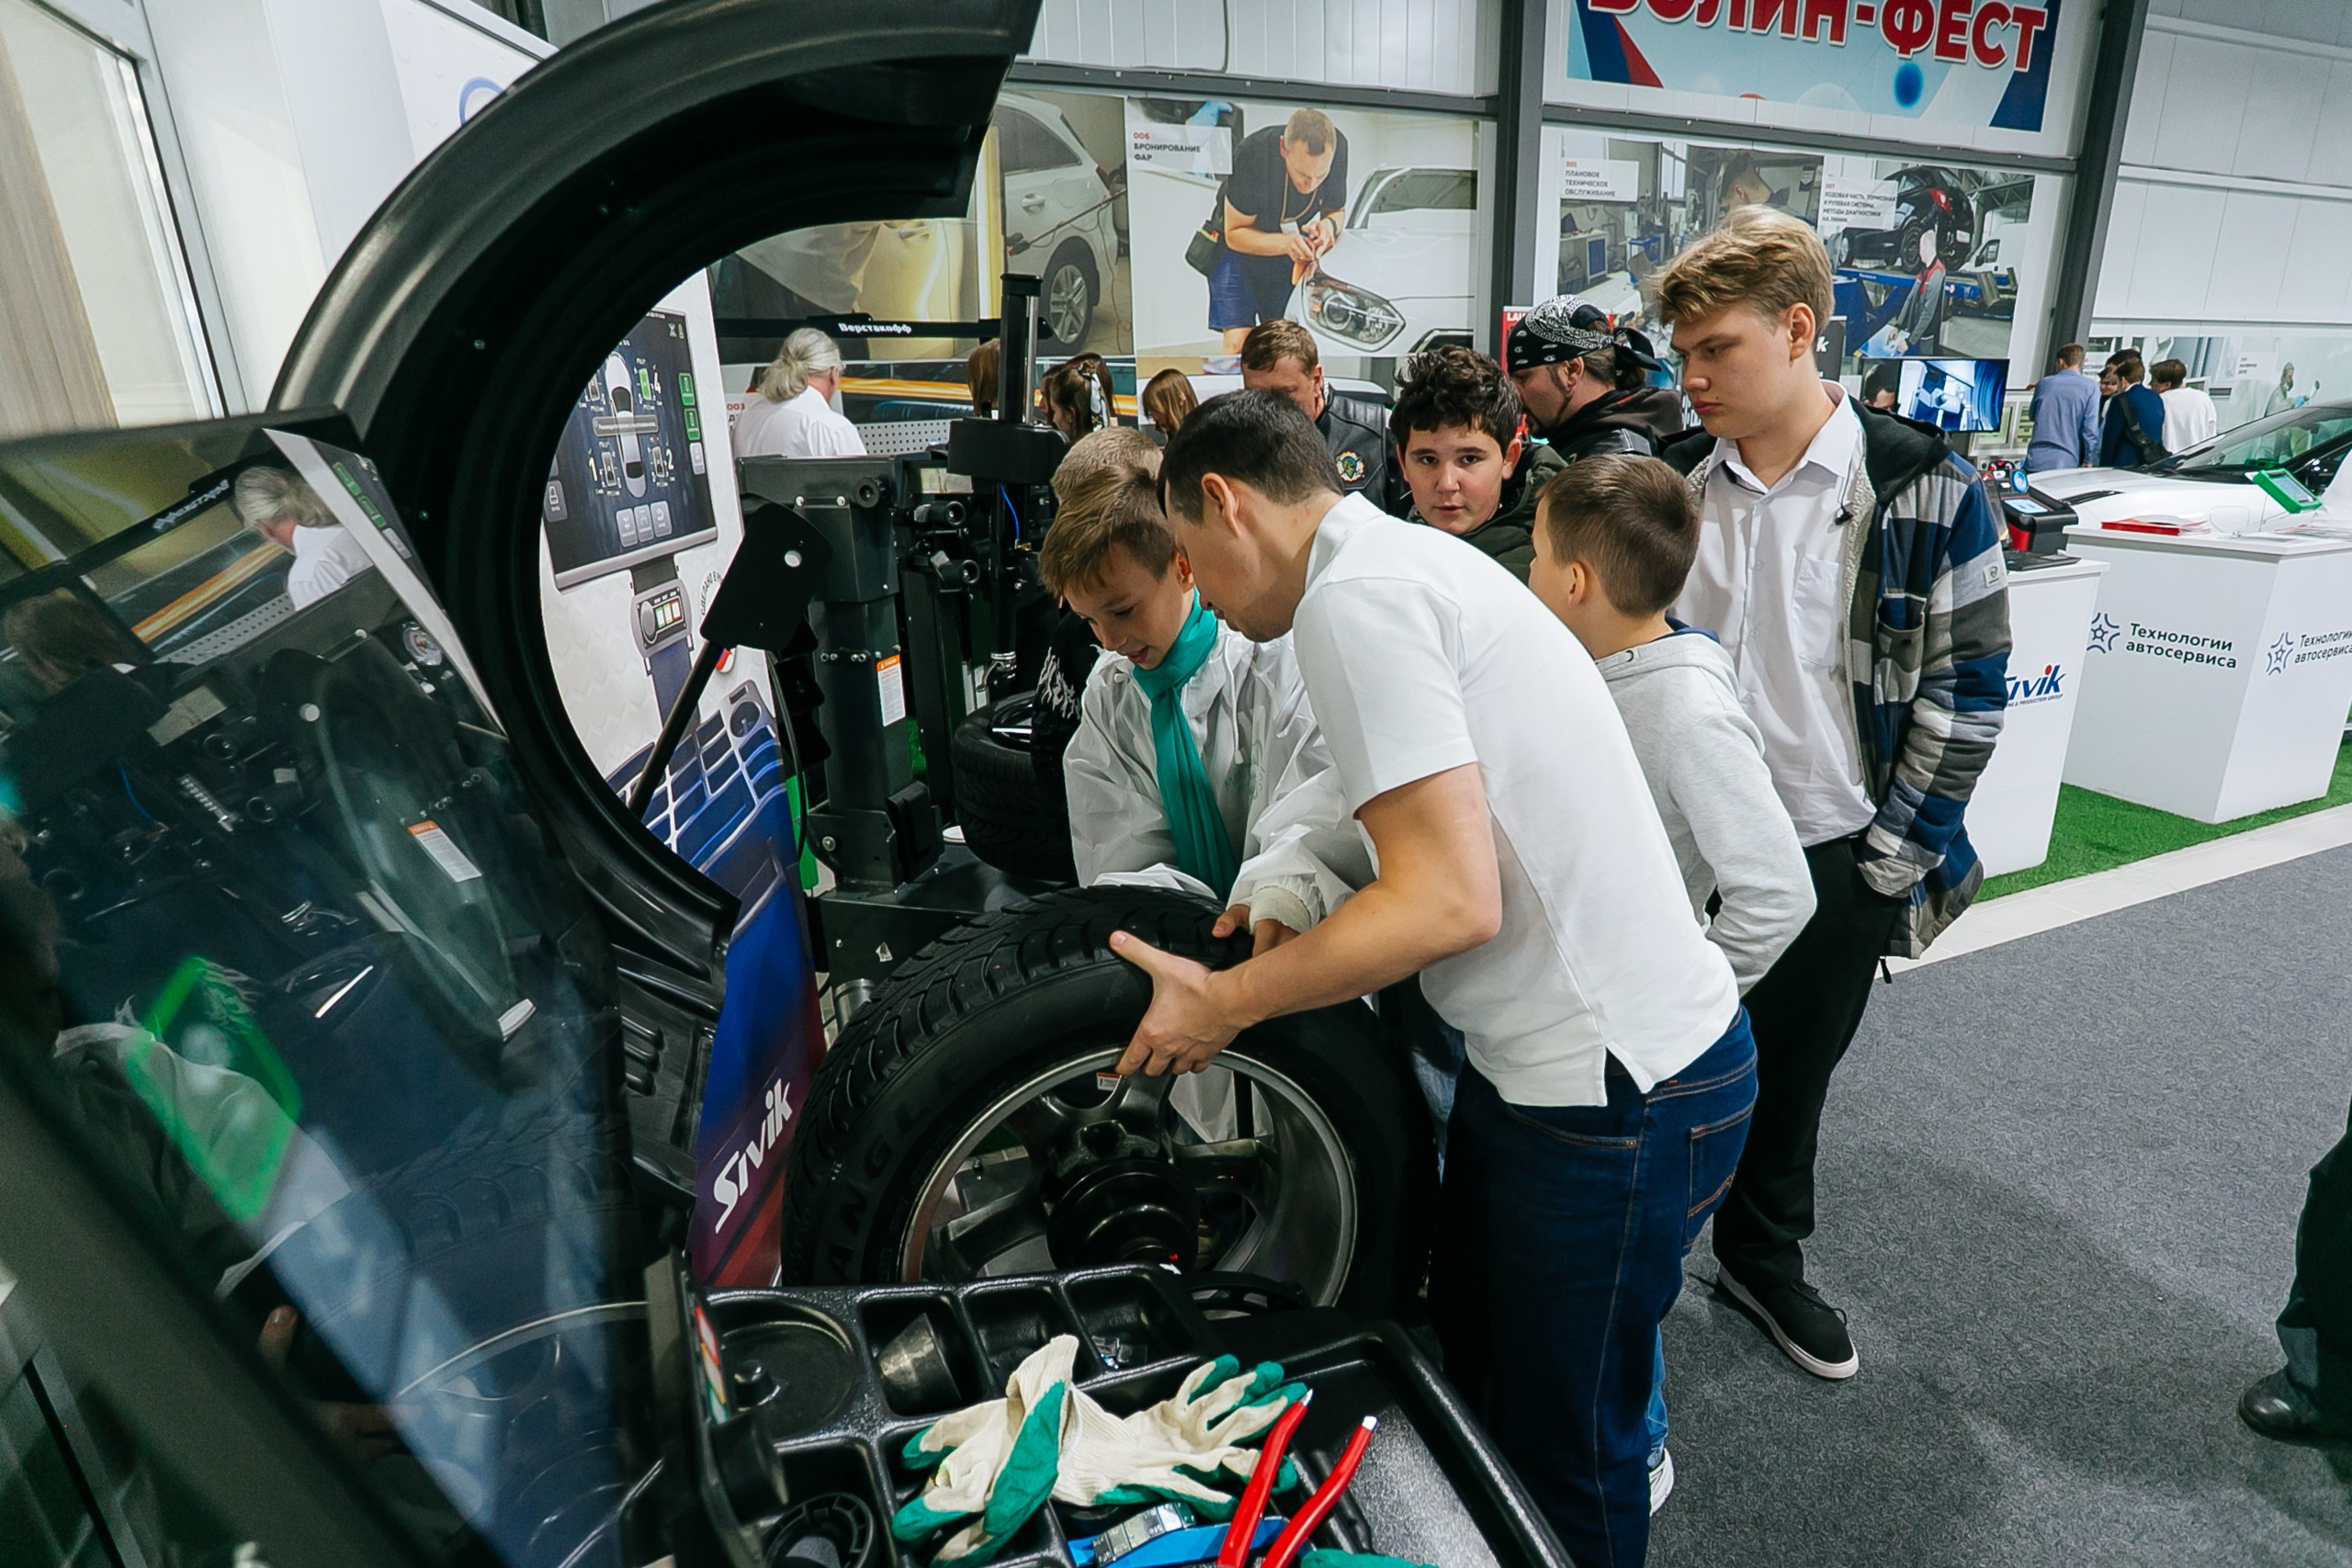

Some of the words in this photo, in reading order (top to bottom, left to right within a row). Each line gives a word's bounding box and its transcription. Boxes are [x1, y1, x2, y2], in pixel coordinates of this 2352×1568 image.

[1589, 0, 2047, 72] ИН-ФЕСТ
[1134, 143, 1201, 152] БРОНИРОВАНИЕ
[1566, 179, 1608, 187] ТЕХНИЧЕСКОЕ
[1507, 312, 1527, 321] LAU
[838, 322, 912, 334] Верстакофф
[2131, 623, 2233, 651] Технологии
[2126, 641, 2236, 669] автосервиса
[2019, 696, 2047, 705] PRODUCTION
